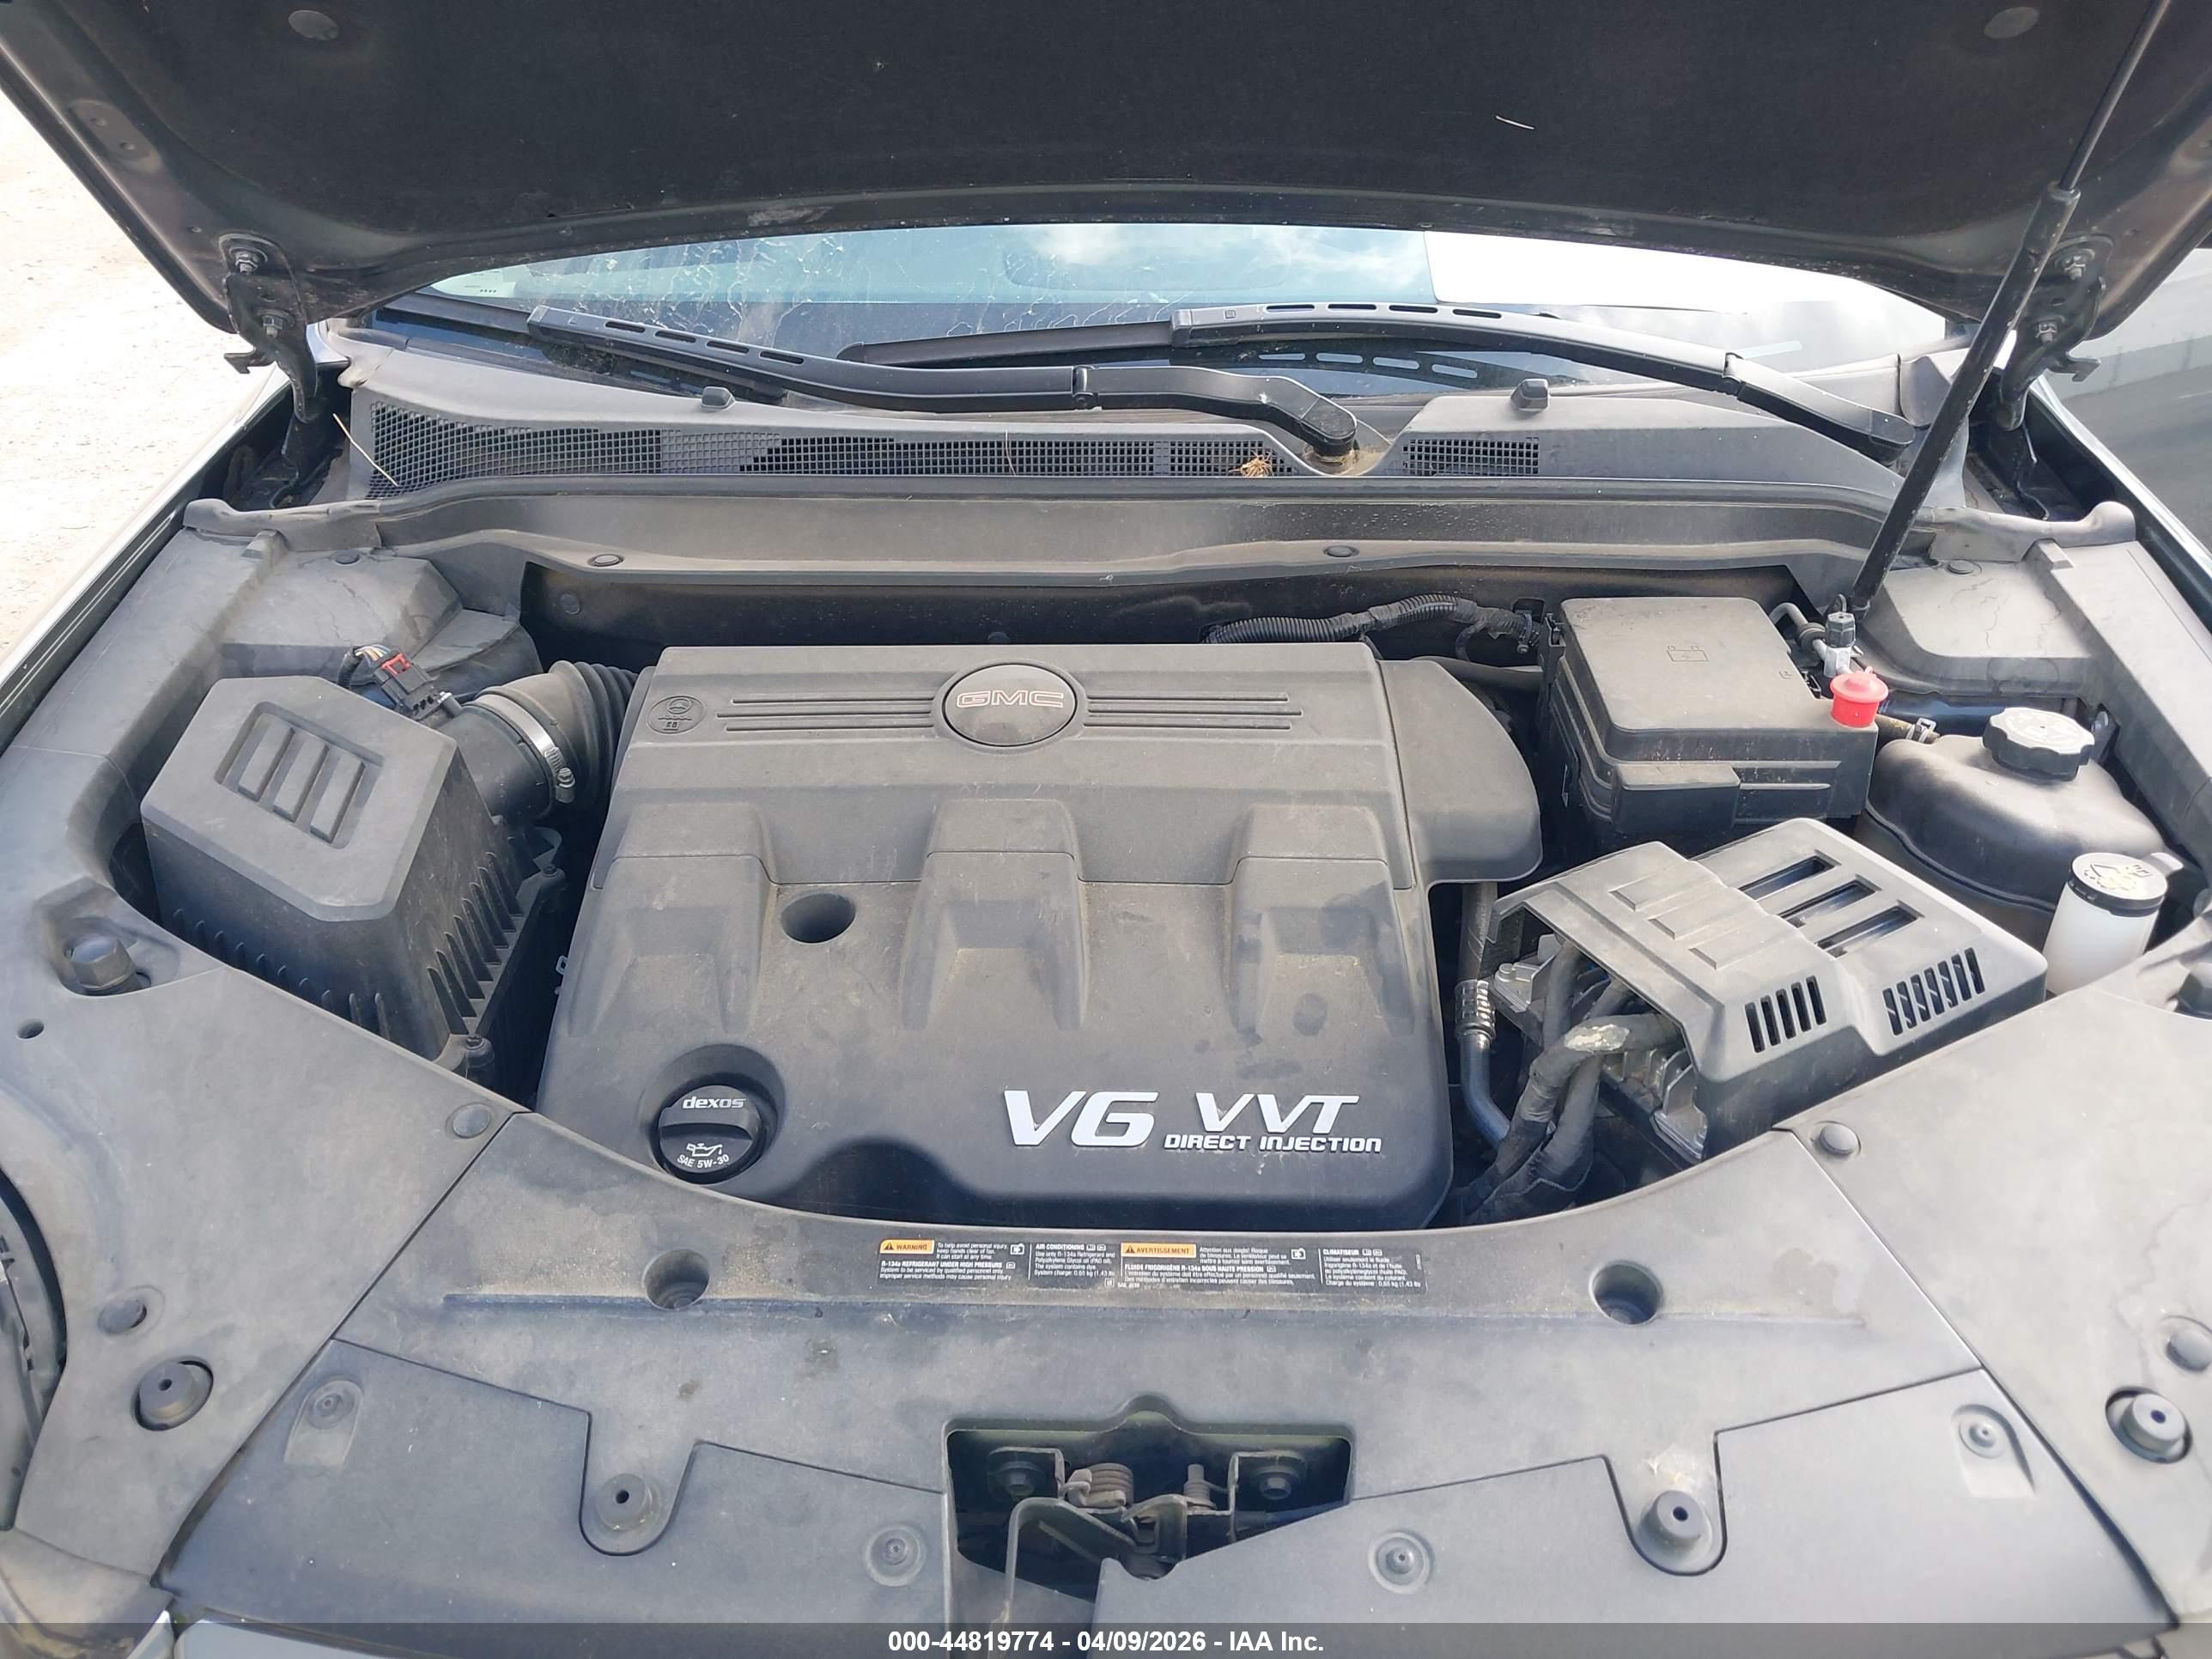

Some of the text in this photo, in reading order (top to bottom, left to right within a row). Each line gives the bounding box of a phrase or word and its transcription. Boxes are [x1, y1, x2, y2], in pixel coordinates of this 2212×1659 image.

[957, 690, 1063, 708] GMC
[683, 1096, 747, 1109] dexos
[1004, 1089, 1360, 1147] V6 VVT
[1163, 1133, 1251, 1152] DIRECT
[677, 1154, 730, 1168] SAE 5W-30
